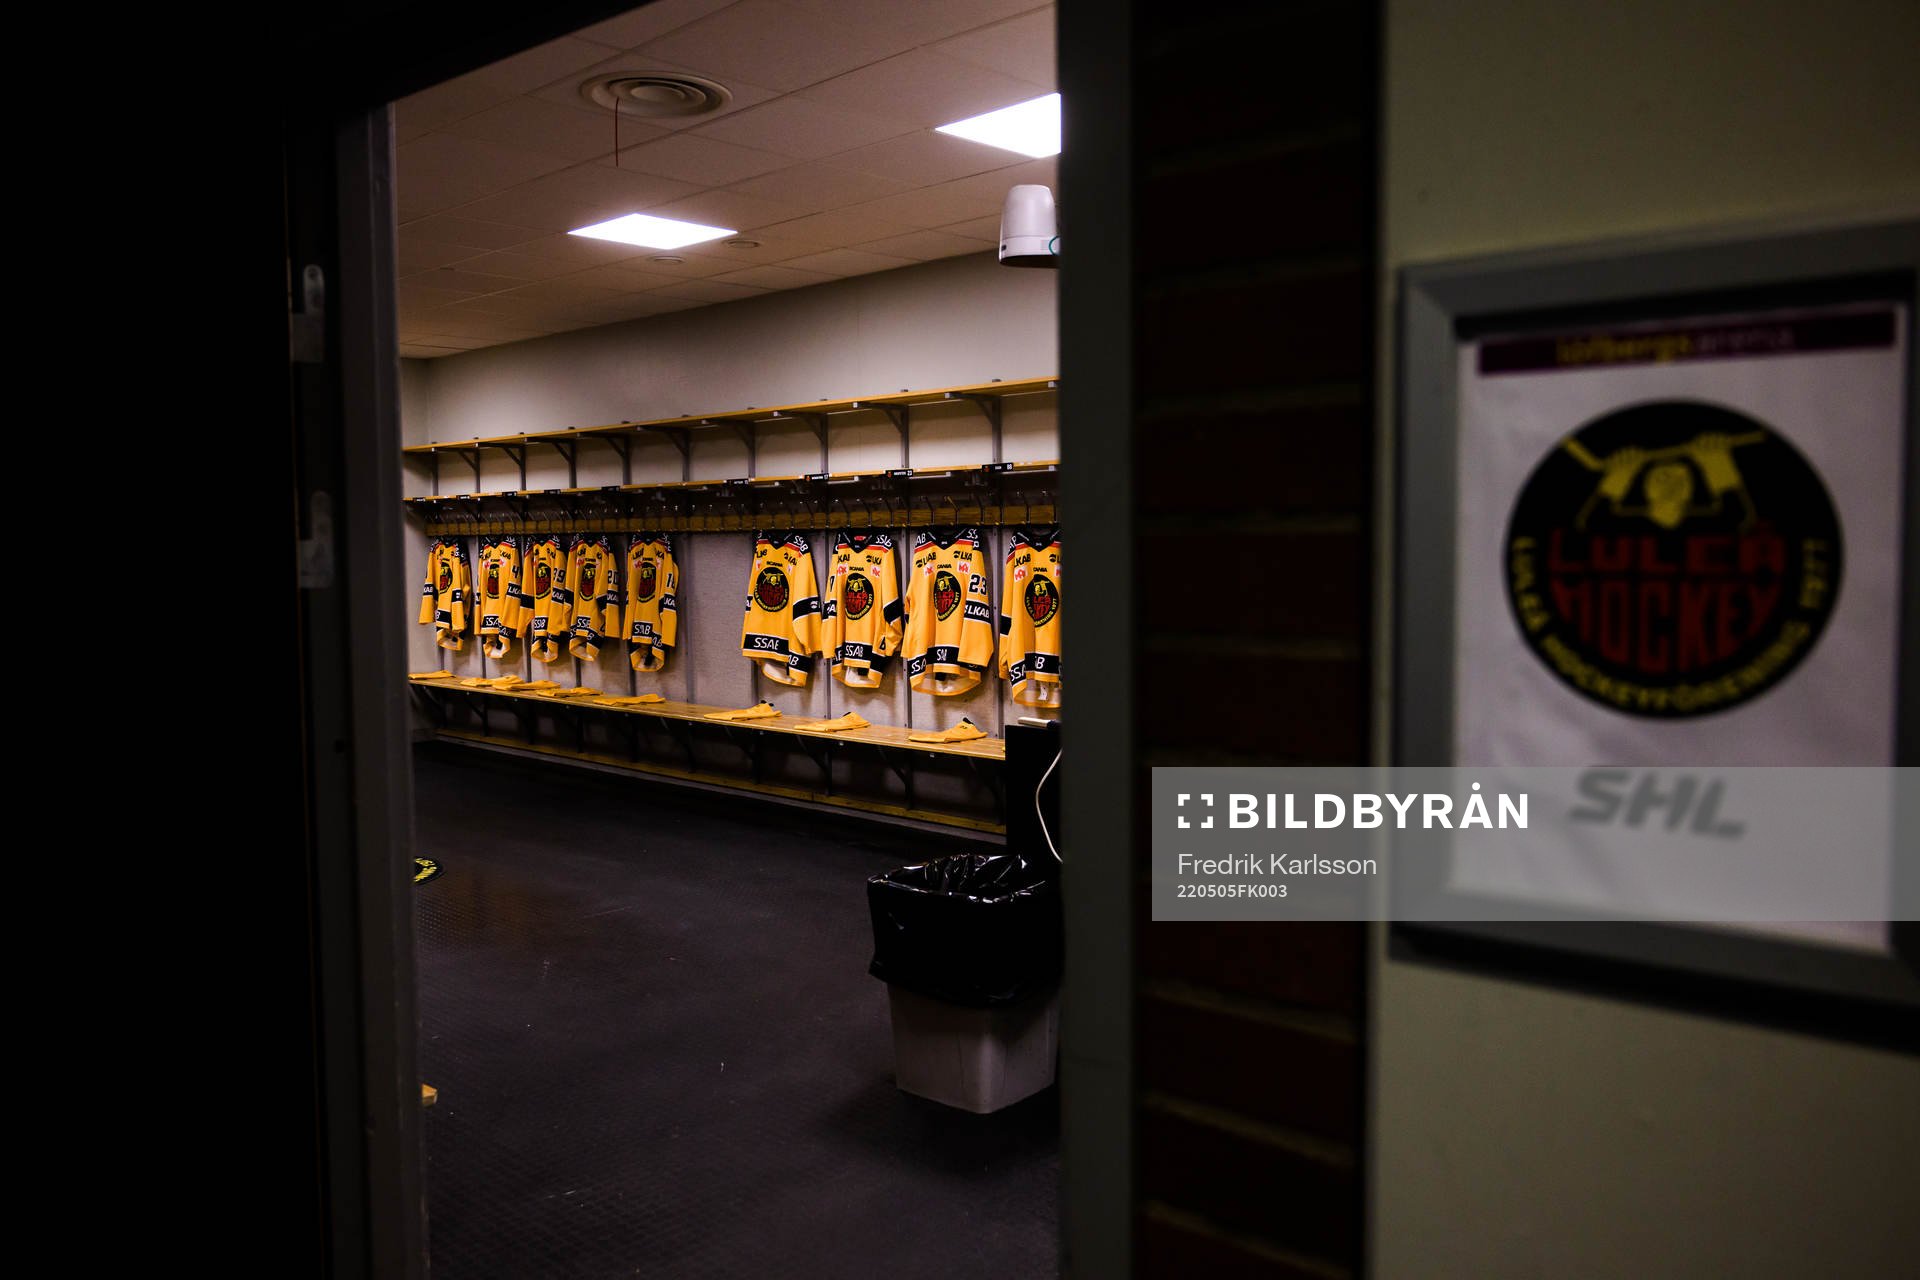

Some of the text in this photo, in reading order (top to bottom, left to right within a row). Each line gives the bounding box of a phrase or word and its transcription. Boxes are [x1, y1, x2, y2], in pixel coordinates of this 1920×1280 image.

[969, 574, 987, 595] 23
[967, 605, 990, 618] LKAB
[1547, 577, 1784, 675] HOCKEY
[1568, 767, 1748, 838] SHL
